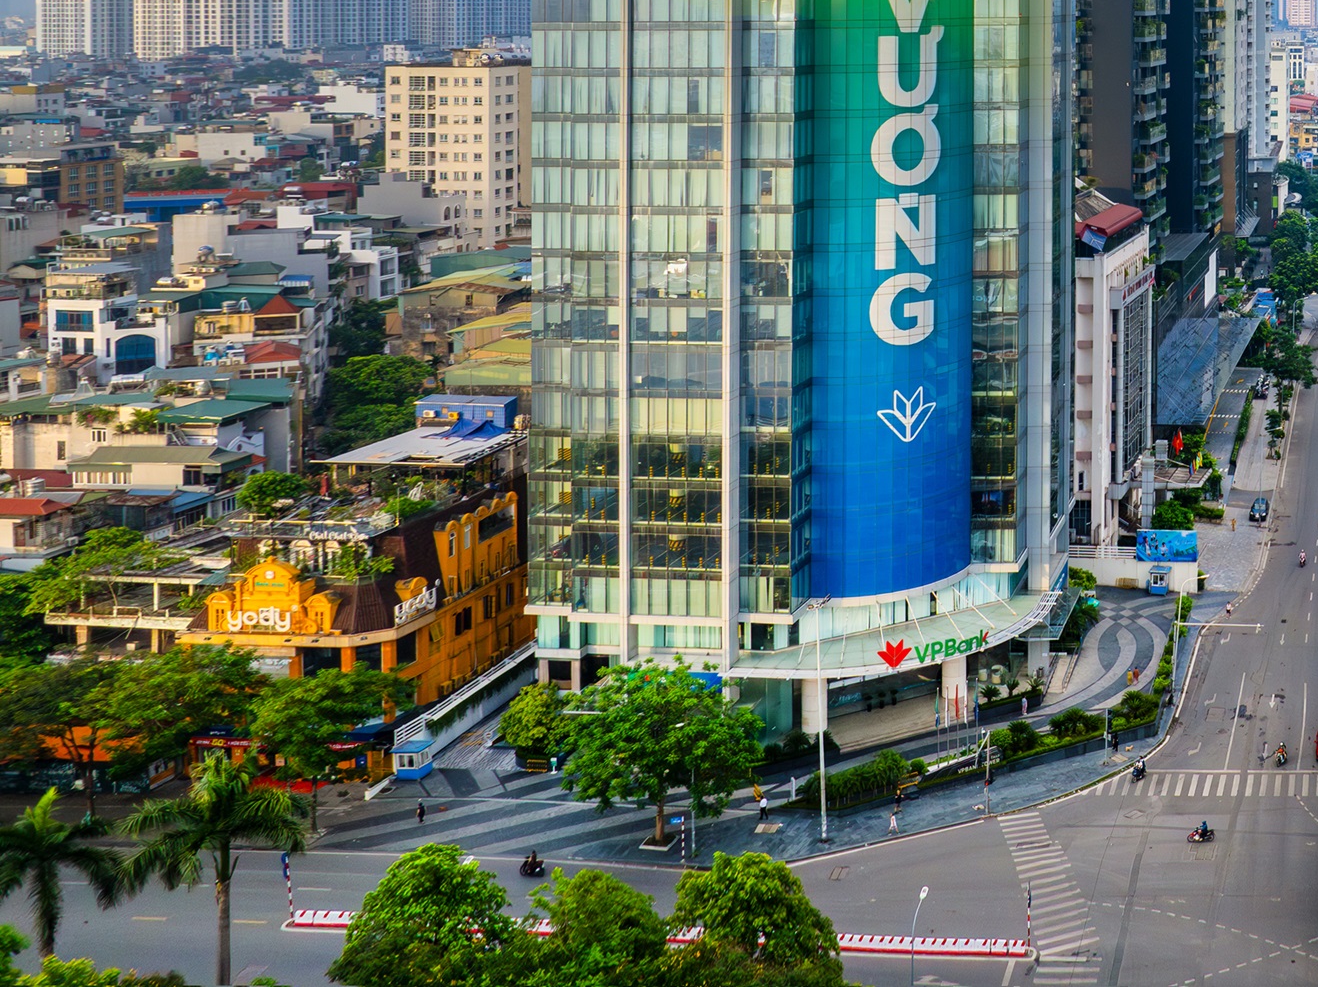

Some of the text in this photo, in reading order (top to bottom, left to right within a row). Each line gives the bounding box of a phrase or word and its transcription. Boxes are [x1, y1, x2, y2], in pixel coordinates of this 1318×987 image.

[227, 606, 291, 632] yody
[394, 586, 437, 625] yody
[914, 629, 989, 663] VPBank
